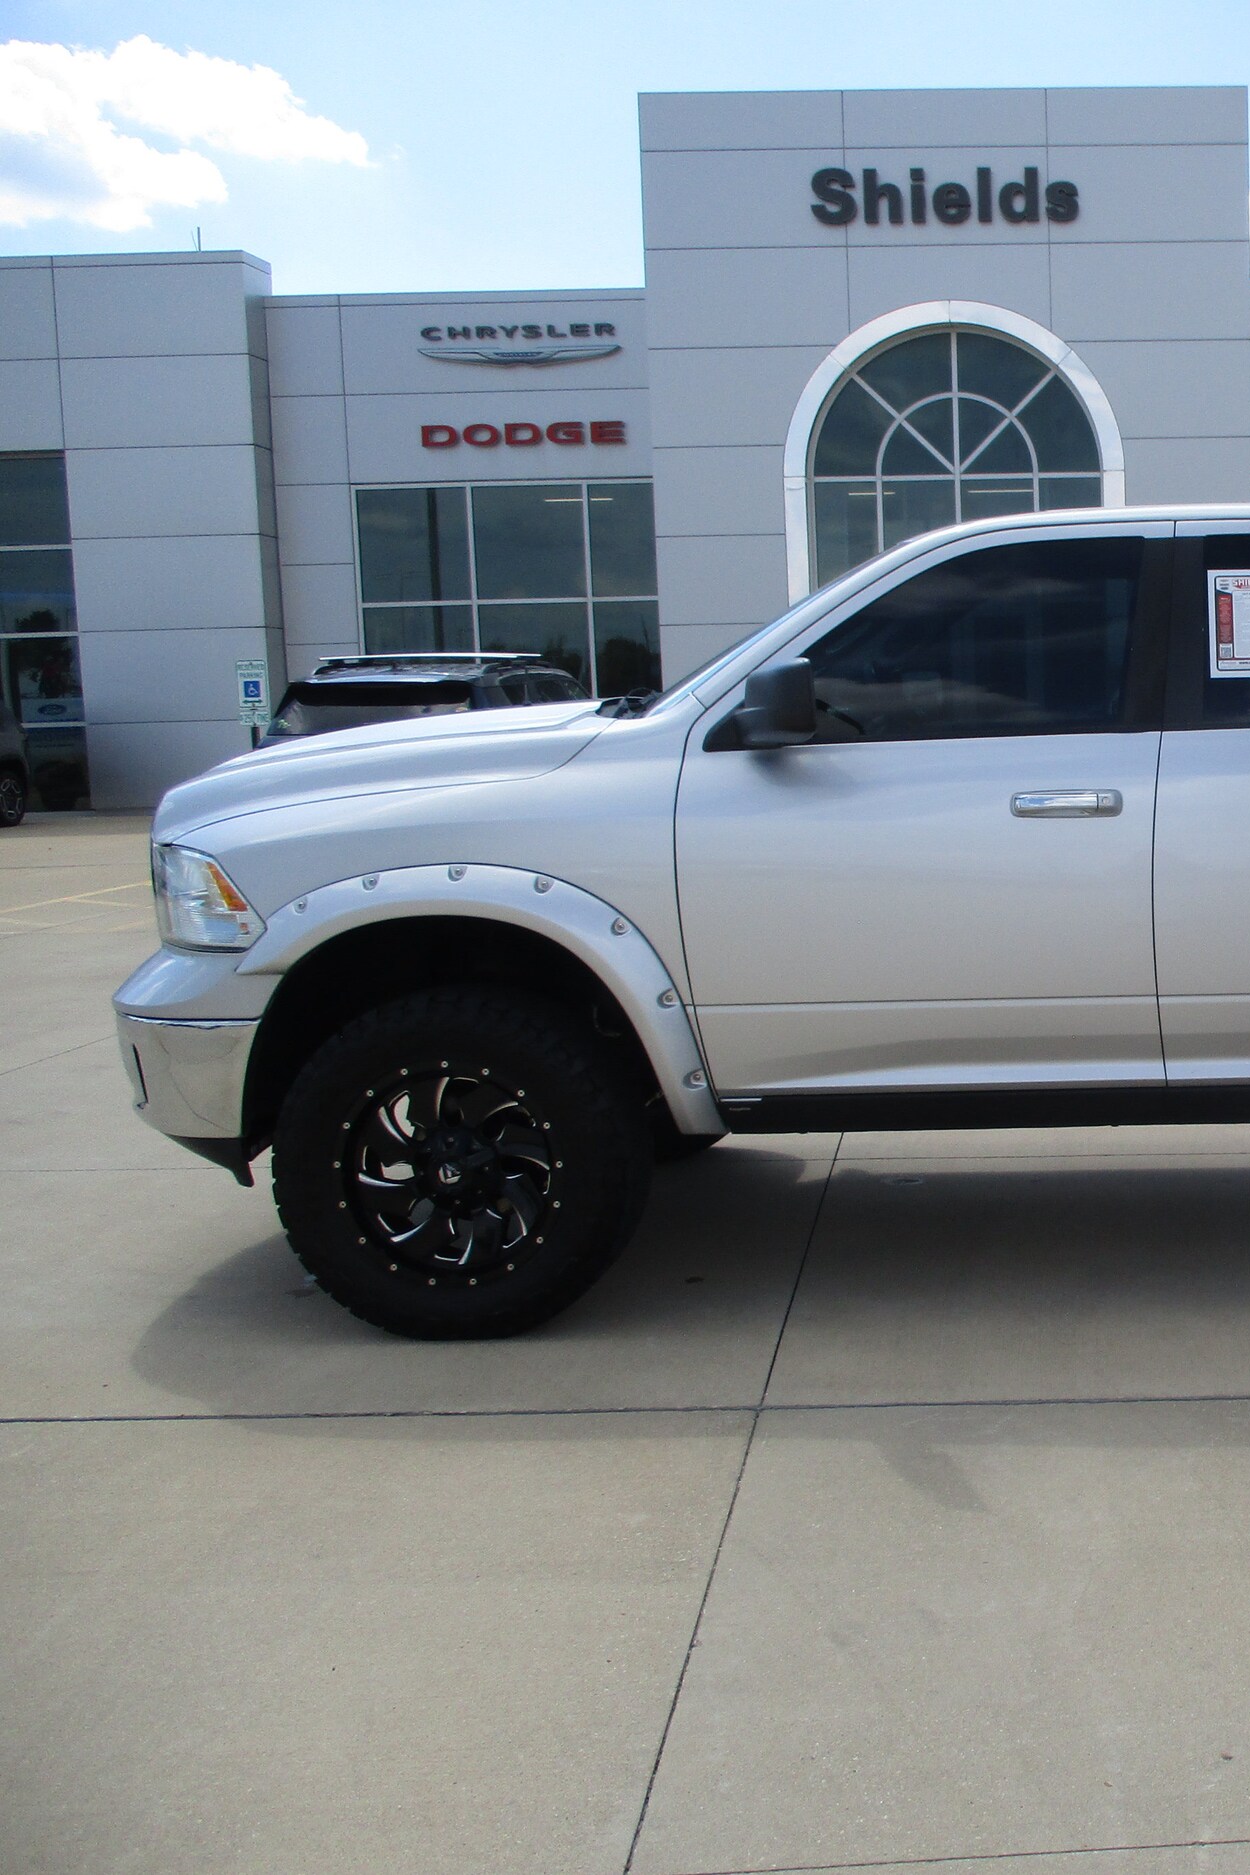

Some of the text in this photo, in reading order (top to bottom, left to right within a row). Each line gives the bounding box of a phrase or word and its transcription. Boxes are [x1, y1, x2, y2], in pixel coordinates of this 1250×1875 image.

[810, 166, 1080, 225] Shields
[420, 323, 616, 342] CHRYSLER
[421, 420, 626, 448] DODGE
